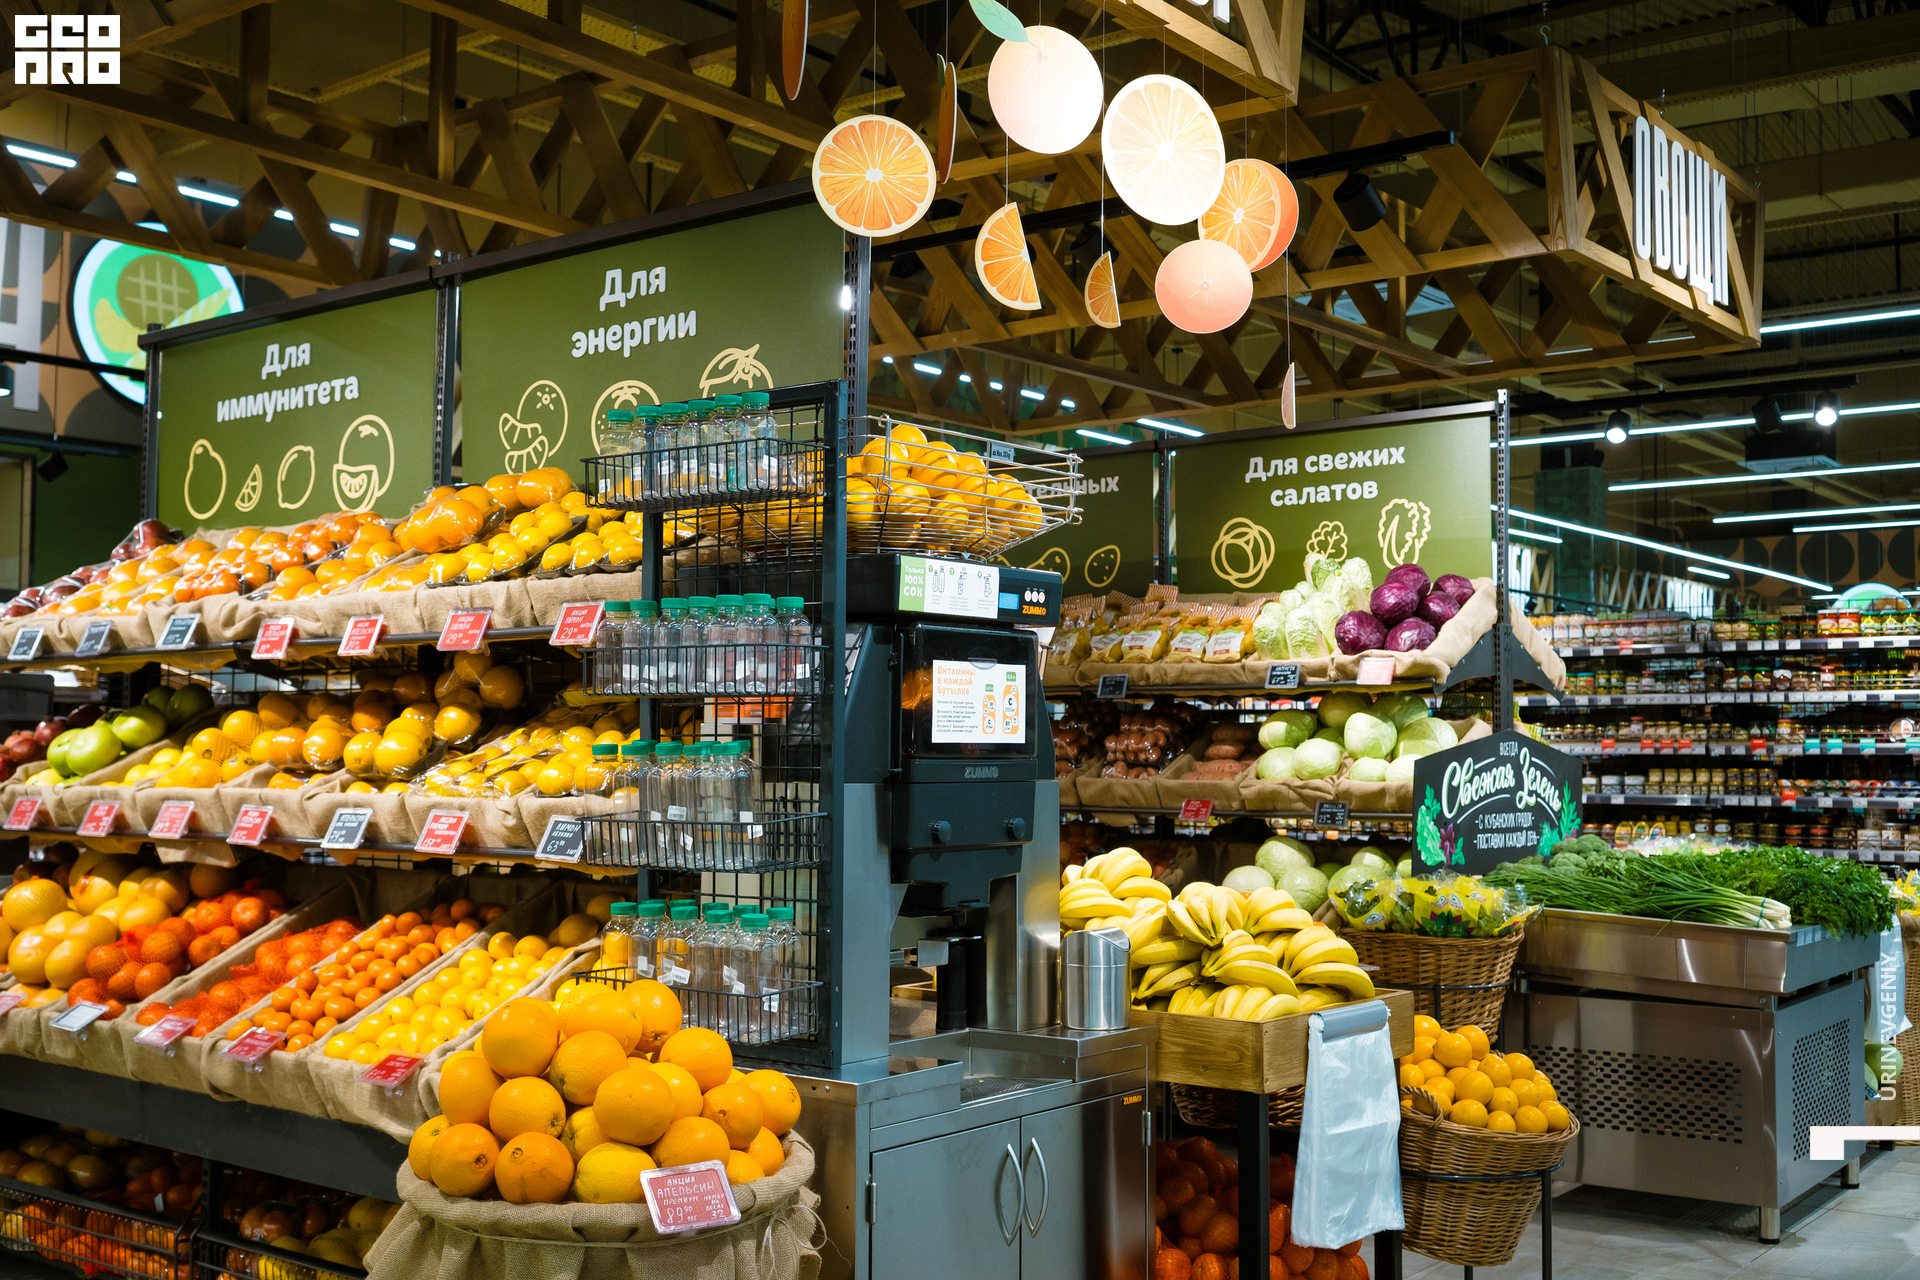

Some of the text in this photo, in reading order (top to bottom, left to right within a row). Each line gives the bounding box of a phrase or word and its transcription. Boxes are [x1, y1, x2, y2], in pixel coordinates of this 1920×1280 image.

[1633, 114, 1729, 307] ОВОЩИ
[600, 265, 666, 311] Для
[571, 309, 697, 359] энергии
[262, 340, 311, 379] Для
[217, 375, 360, 422] иммунитета
[1245, 445, 1406, 483] Для свежих
[1025, 476, 1119, 499] тельных
[1270, 479, 1378, 507] салатов
[904, 565, 925, 575] Только
[904, 574, 924, 585] 100%
[903, 586, 923, 598] СОК
[1022, 605, 1046, 616] ZUMMO
[937, 666, 976, 676] Витамины
[943, 677, 973, 686] каждой
[937, 685, 970, 697] бутылке
[1499, 741, 1519, 757] ВСЕГДА
[964, 766, 999, 779] ZUMMO
[1441, 746, 1562, 819] Свежая Зелень
[555, 823, 581, 833] ЛИМОН
[1484, 812, 1515, 829] КУБАНСКИХ
[1505, 829, 1526, 848] КАЖДЫЙ
[1123, 1094, 1143, 1105] ZUMMO
[667, 1175, 696, 1187] АКЦИЯ
[657, 1181, 715, 1199] АПЕЛЬСИН
[663, 1196, 699, 1206] ПРЕМИУМ
